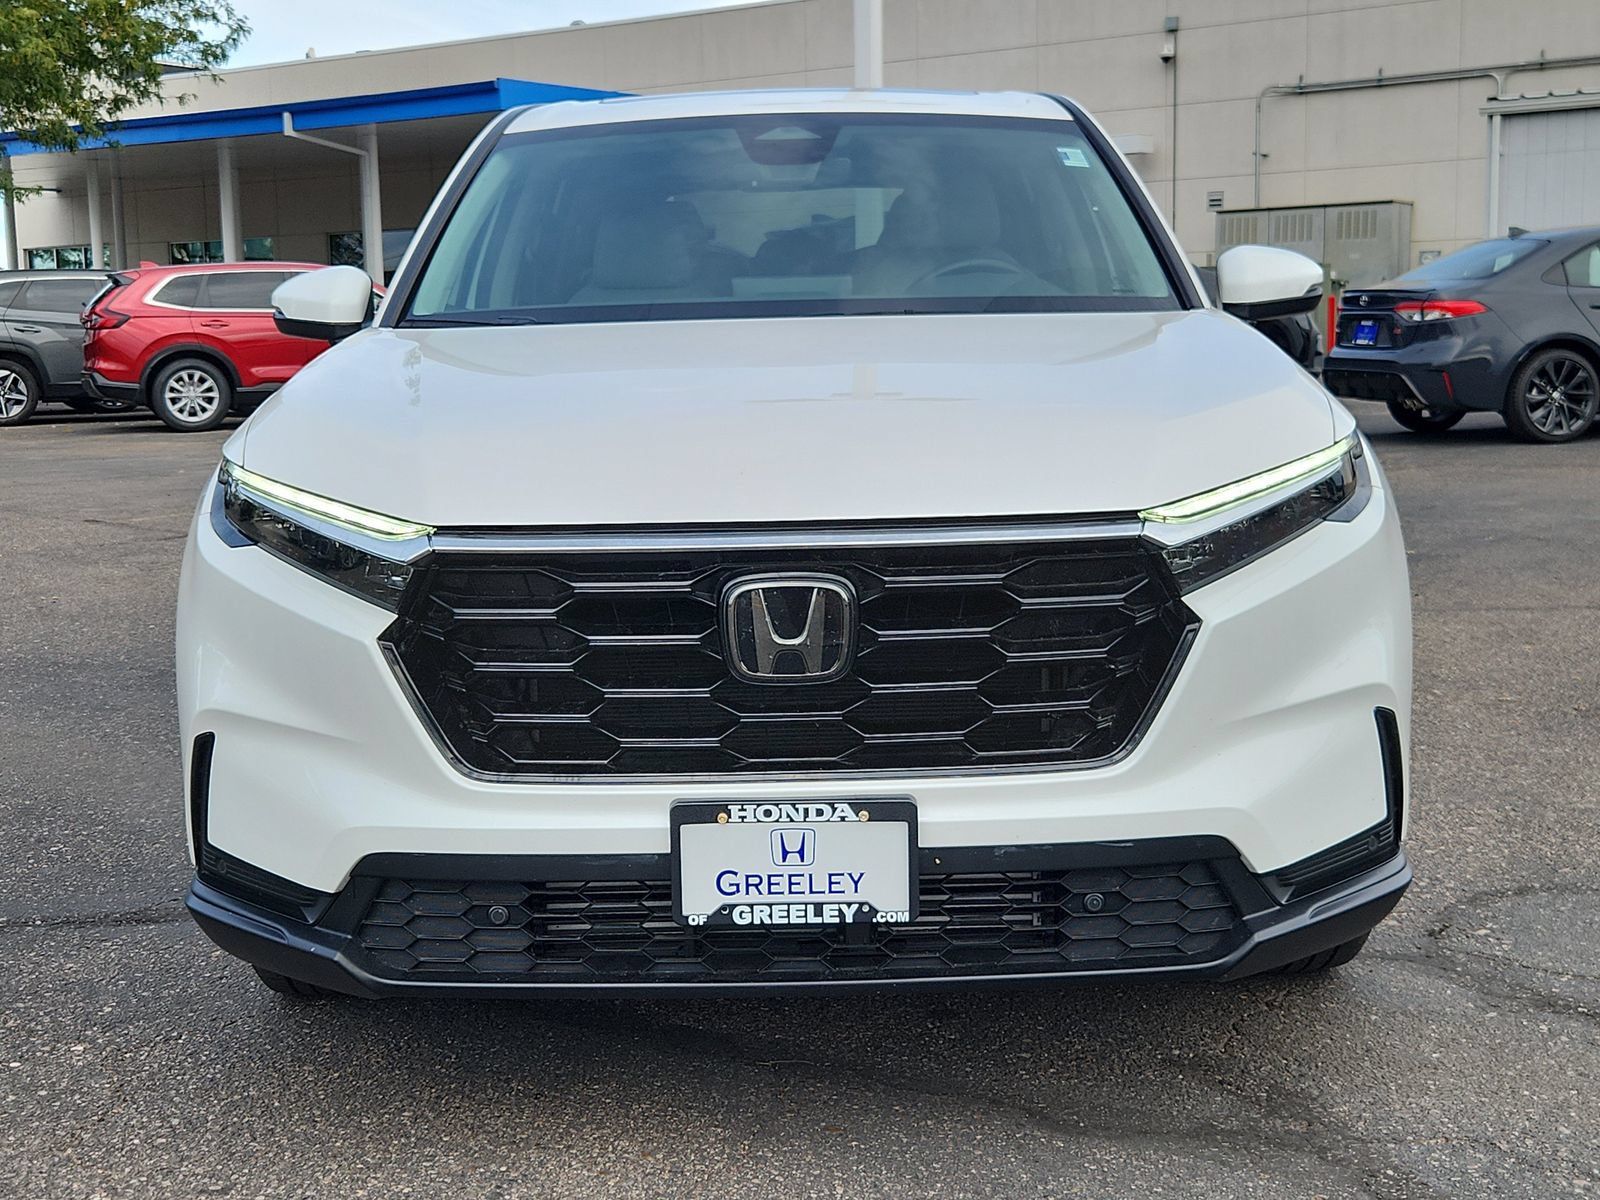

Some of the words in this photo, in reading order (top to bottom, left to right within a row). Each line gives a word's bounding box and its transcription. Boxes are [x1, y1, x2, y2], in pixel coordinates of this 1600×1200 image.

[727, 803, 860, 823] HONDA
[687, 914, 708, 926] OF
[732, 903, 860, 925] GREELEY
[872, 911, 910, 924] .COM
